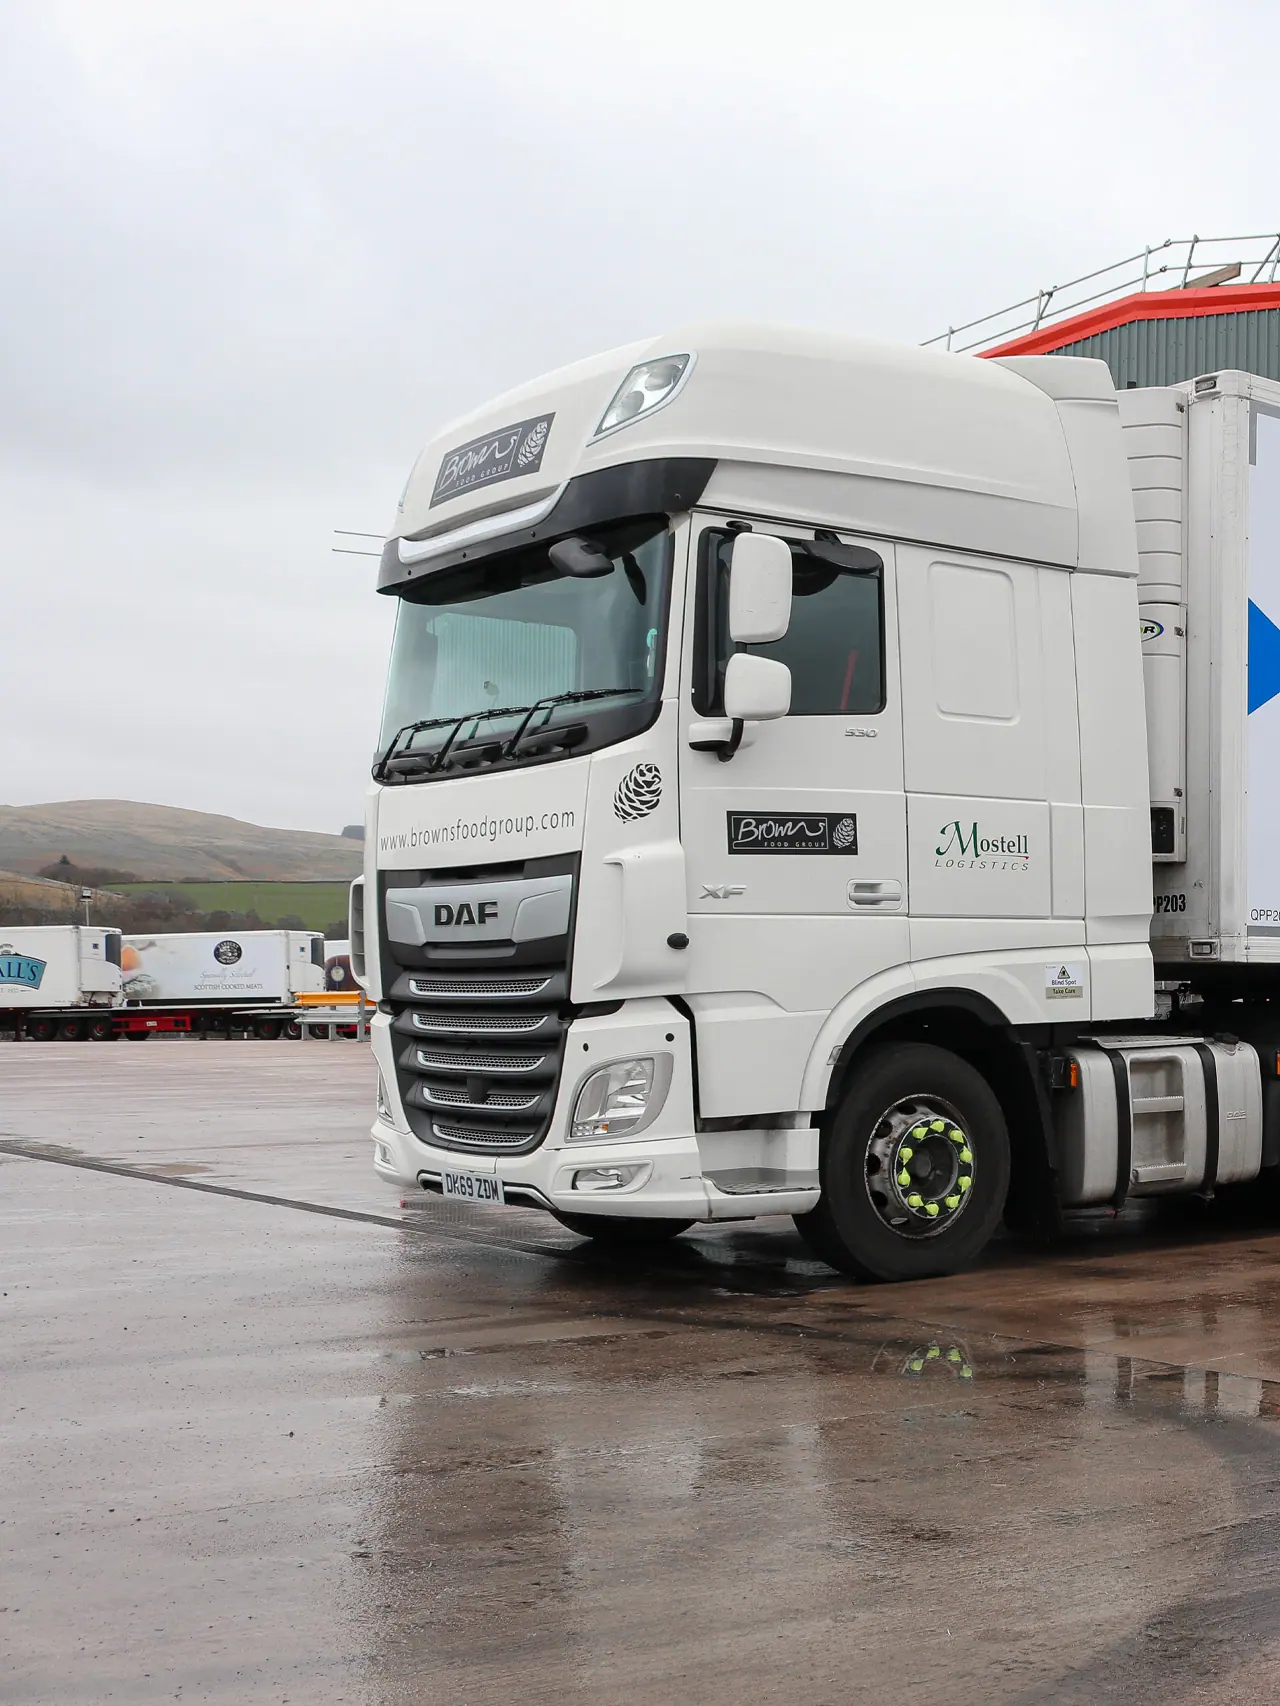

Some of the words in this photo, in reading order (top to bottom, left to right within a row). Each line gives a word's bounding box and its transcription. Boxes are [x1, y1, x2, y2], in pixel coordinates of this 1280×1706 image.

[455, 474, 477, 488] FOOD
[480, 463, 509, 481] GROUP
[380, 810, 576, 851] www.brownsfoodgroup.com
[935, 821, 1029, 858] Mostell
[935, 859, 1029, 871] LOGISTICS
[699, 884, 747, 899] XF
[1153, 894, 1186, 913] P203
[434, 901, 499, 927] DAF
[0, 961, 39, 981] LL'S
[446, 1173, 473, 1197] DK69
[475, 1177, 499, 1201] ZDM
